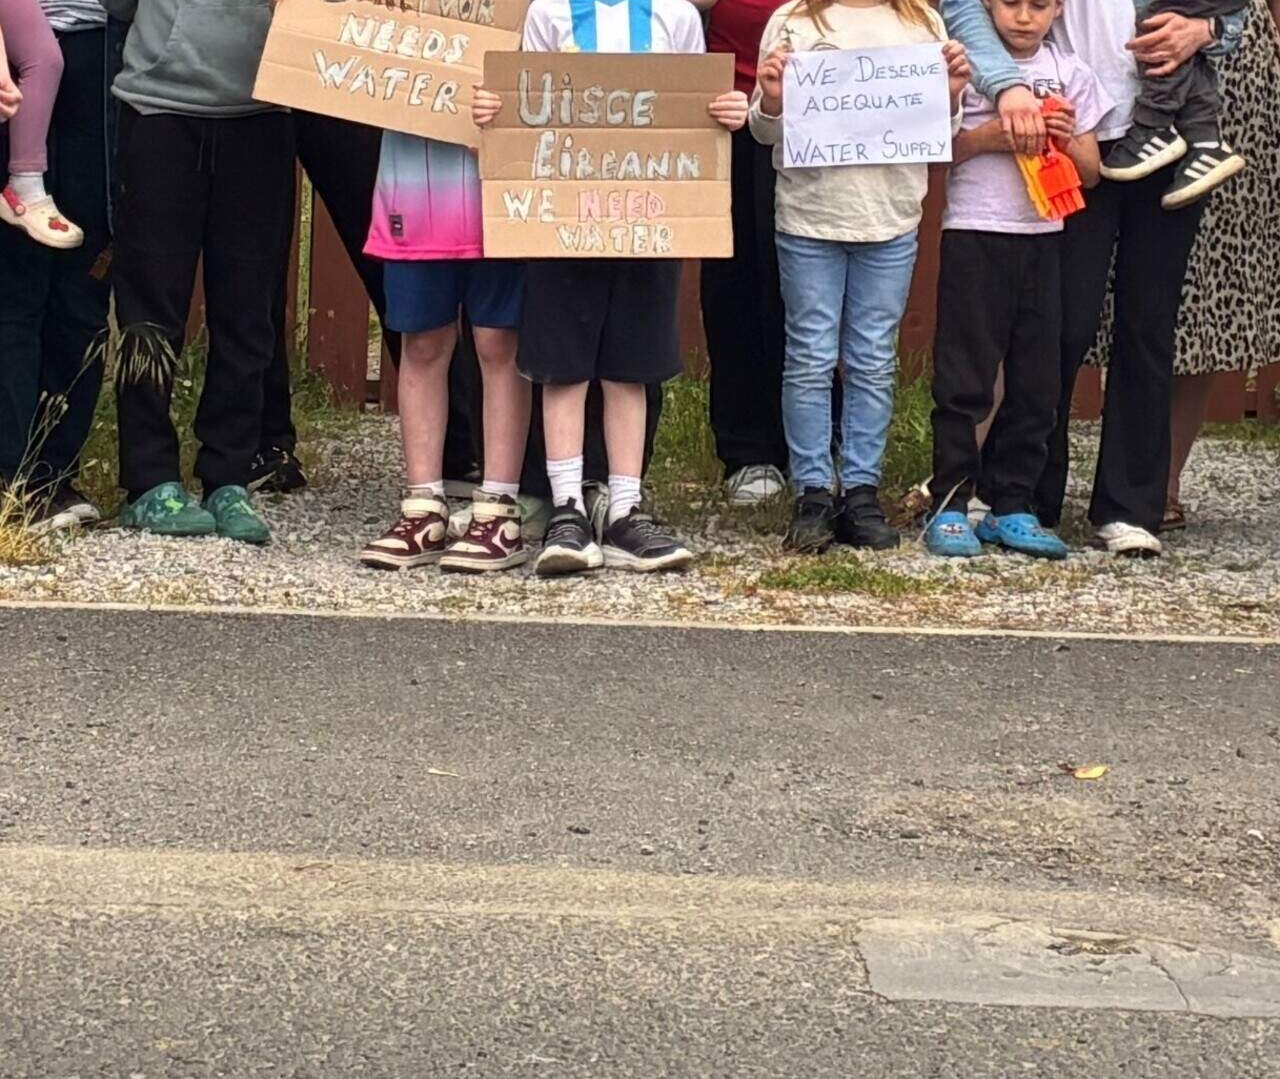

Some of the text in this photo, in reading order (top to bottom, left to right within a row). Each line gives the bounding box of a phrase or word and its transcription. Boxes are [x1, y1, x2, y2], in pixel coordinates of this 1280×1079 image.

[336, 12, 470, 64] NEEDS
[313, 48, 461, 115] WATER
[792, 55, 940, 87] WE DESERVE
[803, 92, 923, 116] ADEQUATE
[786, 129, 946, 165] WATER SUPPLY
[503, 188, 665, 223] WE NEED
[557, 223, 673, 255] WATER
